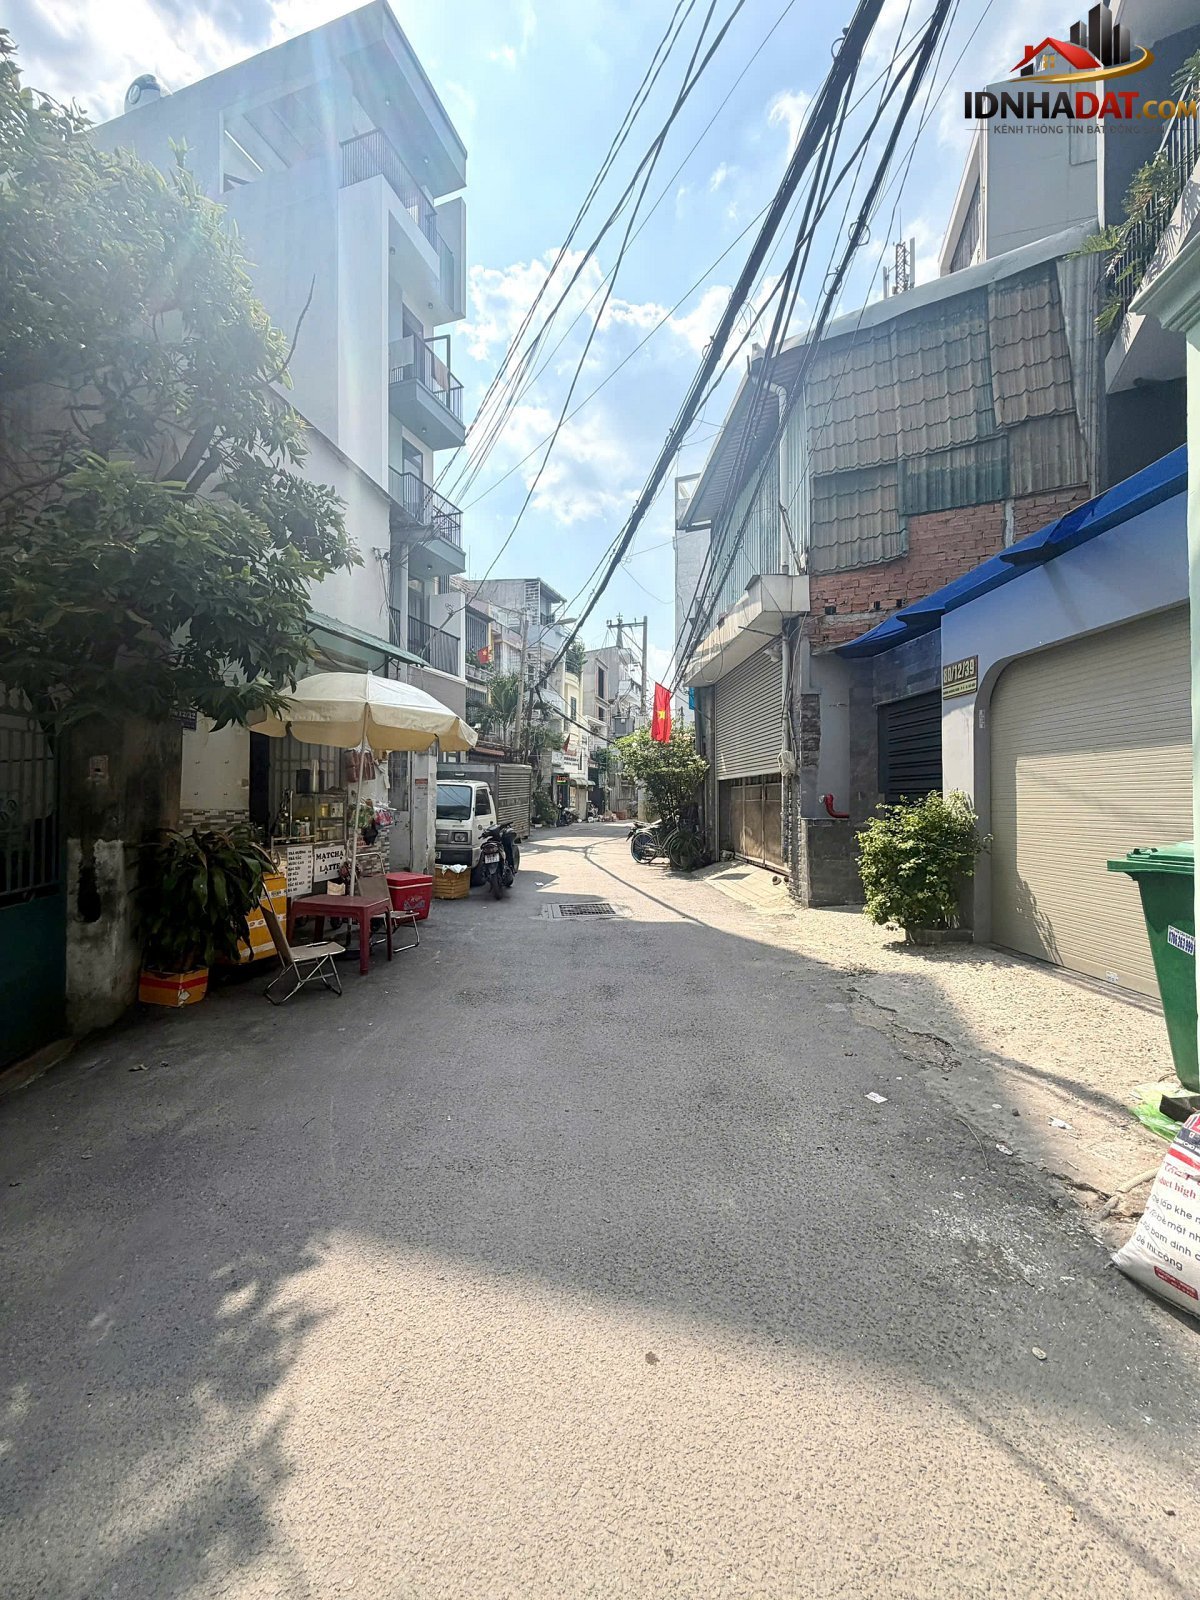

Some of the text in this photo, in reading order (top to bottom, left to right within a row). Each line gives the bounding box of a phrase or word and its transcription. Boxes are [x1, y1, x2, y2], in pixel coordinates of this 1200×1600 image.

[943, 658, 975, 683] 80/12/39
[316, 851, 344, 861] MATCHA
[319, 862, 341, 873] LATTE
[1174, 1182, 1197, 1199] high
[1174, 1205, 1193, 1220] khe
